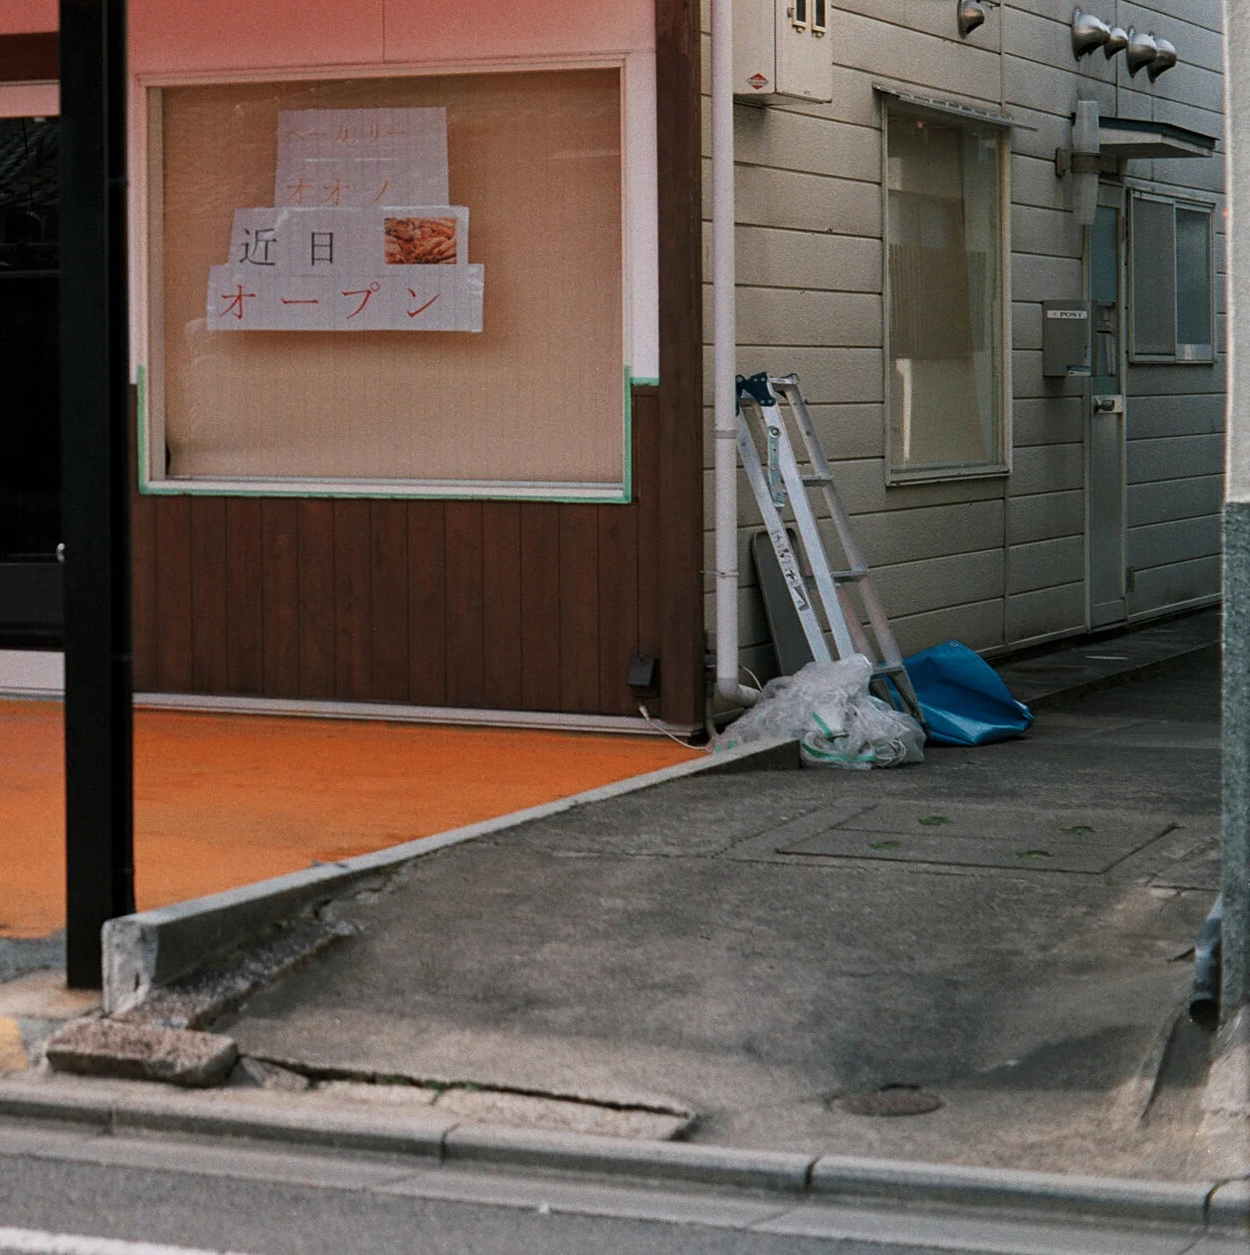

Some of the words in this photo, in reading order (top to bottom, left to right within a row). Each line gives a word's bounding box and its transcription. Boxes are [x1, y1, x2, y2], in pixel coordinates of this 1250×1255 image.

[283, 178, 388, 205] オオノ
[239, 228, 335, 266] 近日
[219, 281, 440, 320] オープン
